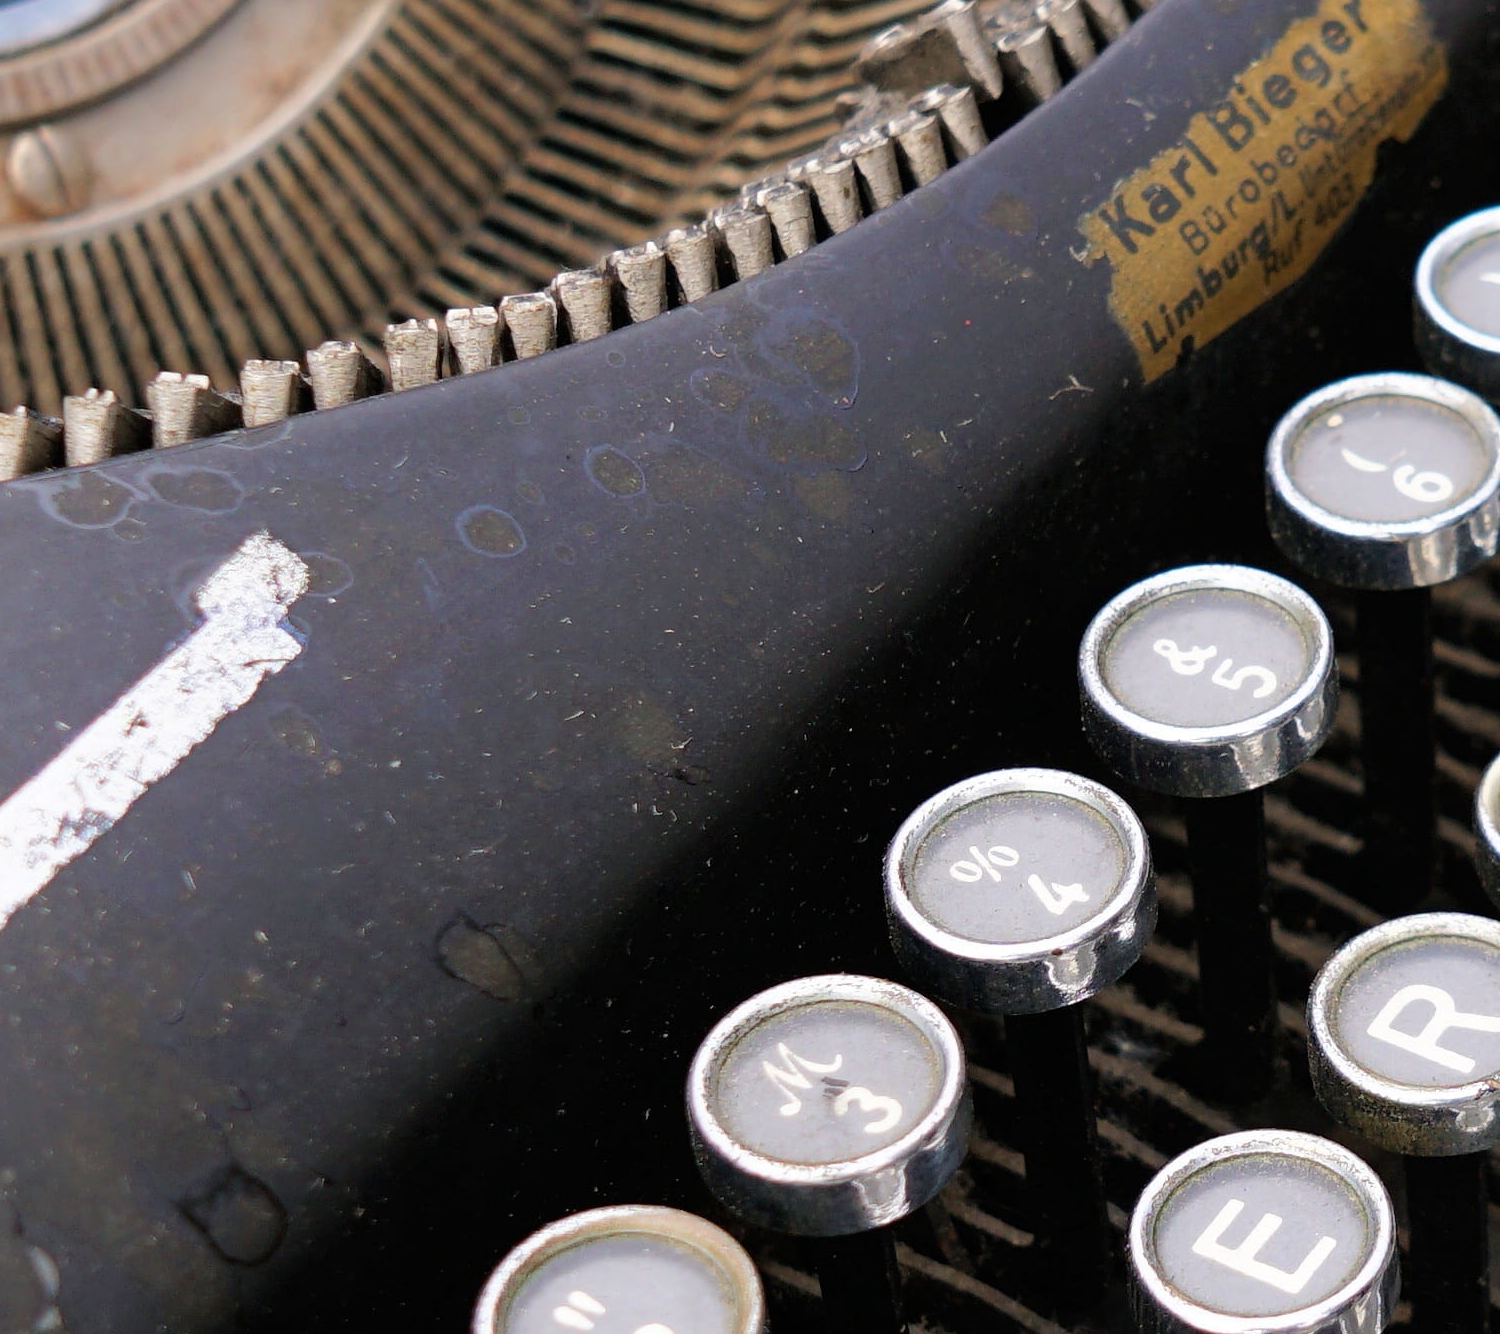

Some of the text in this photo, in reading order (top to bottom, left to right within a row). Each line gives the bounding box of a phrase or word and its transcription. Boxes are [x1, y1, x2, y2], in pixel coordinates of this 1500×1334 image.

[1178, 69, 1361, 256] Bürobedarf
[1100, 134, 1218, 254] Karl
[1393, 464, 1453, 502] 6
[1153, 639, 1219, 678] &
[1217, 659, 1277, 698] 5
[950, 846, 1019, 882] %
[1022, 874, 1090, 915] 4
[835, 1087, 902, 1134] 3
[1192, 1199, 1336, 1294] E
